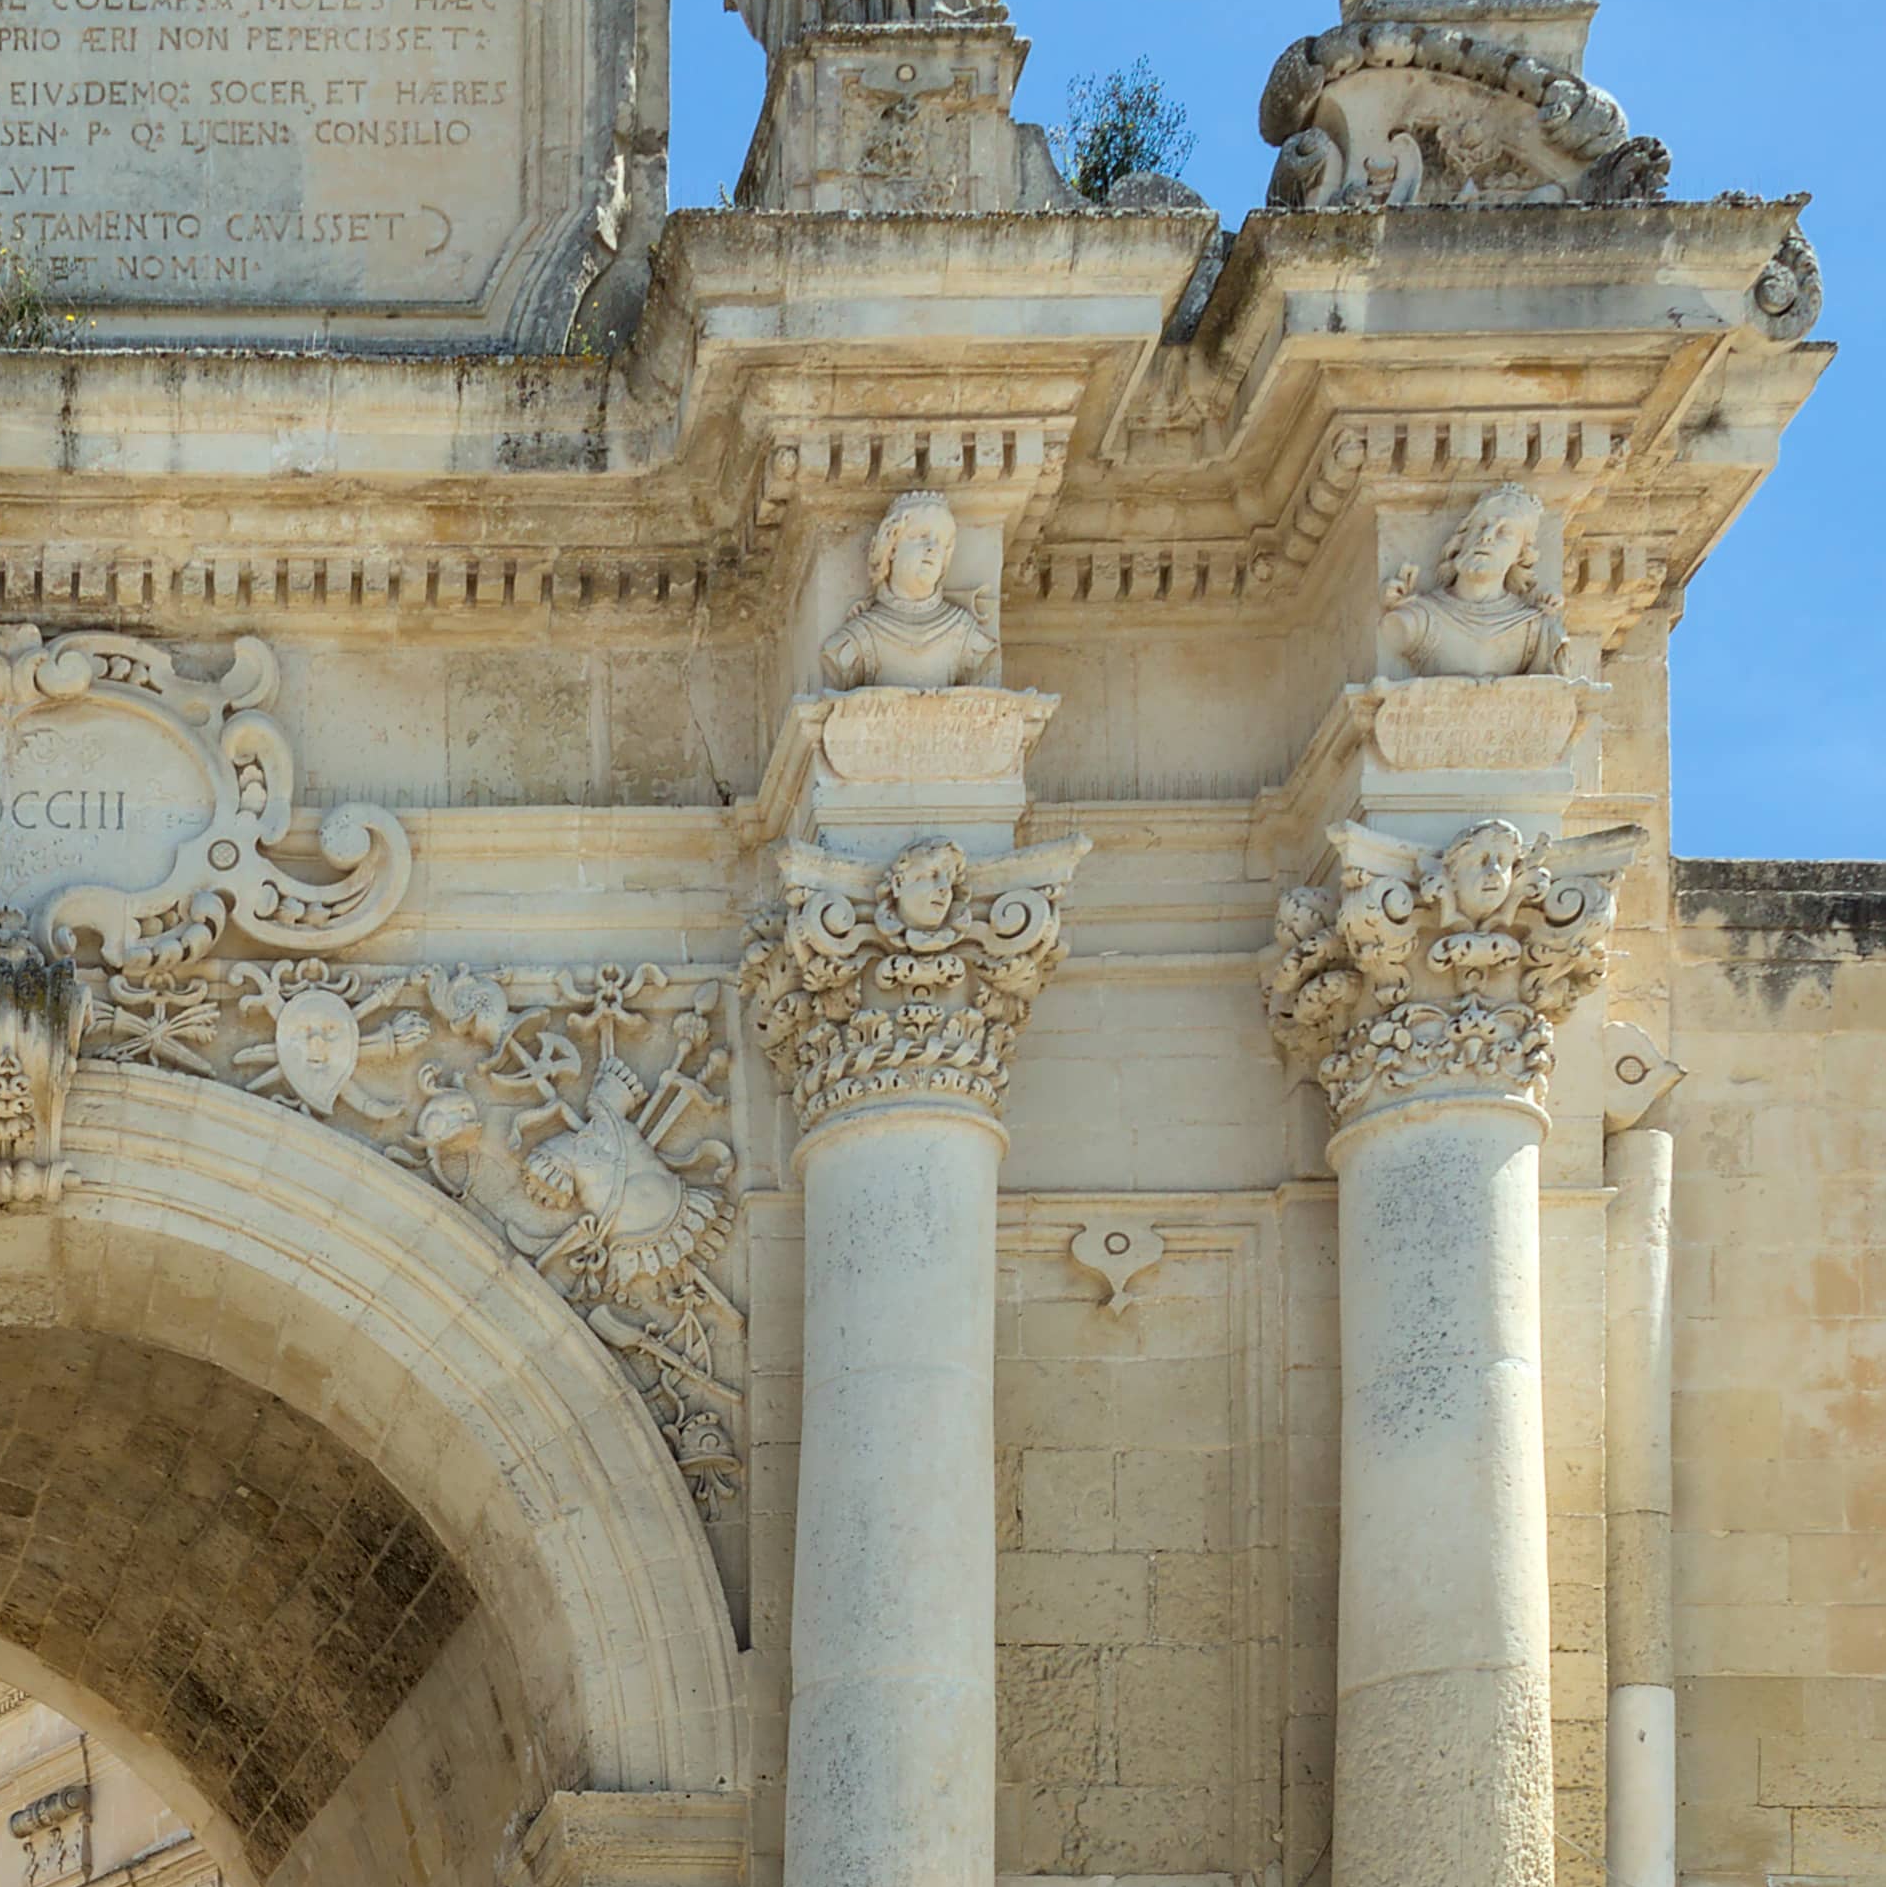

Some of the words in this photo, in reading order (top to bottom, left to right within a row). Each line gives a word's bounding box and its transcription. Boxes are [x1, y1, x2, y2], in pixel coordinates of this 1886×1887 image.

[157, 26, 230, 52] NON
[325, 79, 368, 106] ET
[395, 79, 507, 106] HÆRES
[315, 119, 471, 148] CONSILIO
